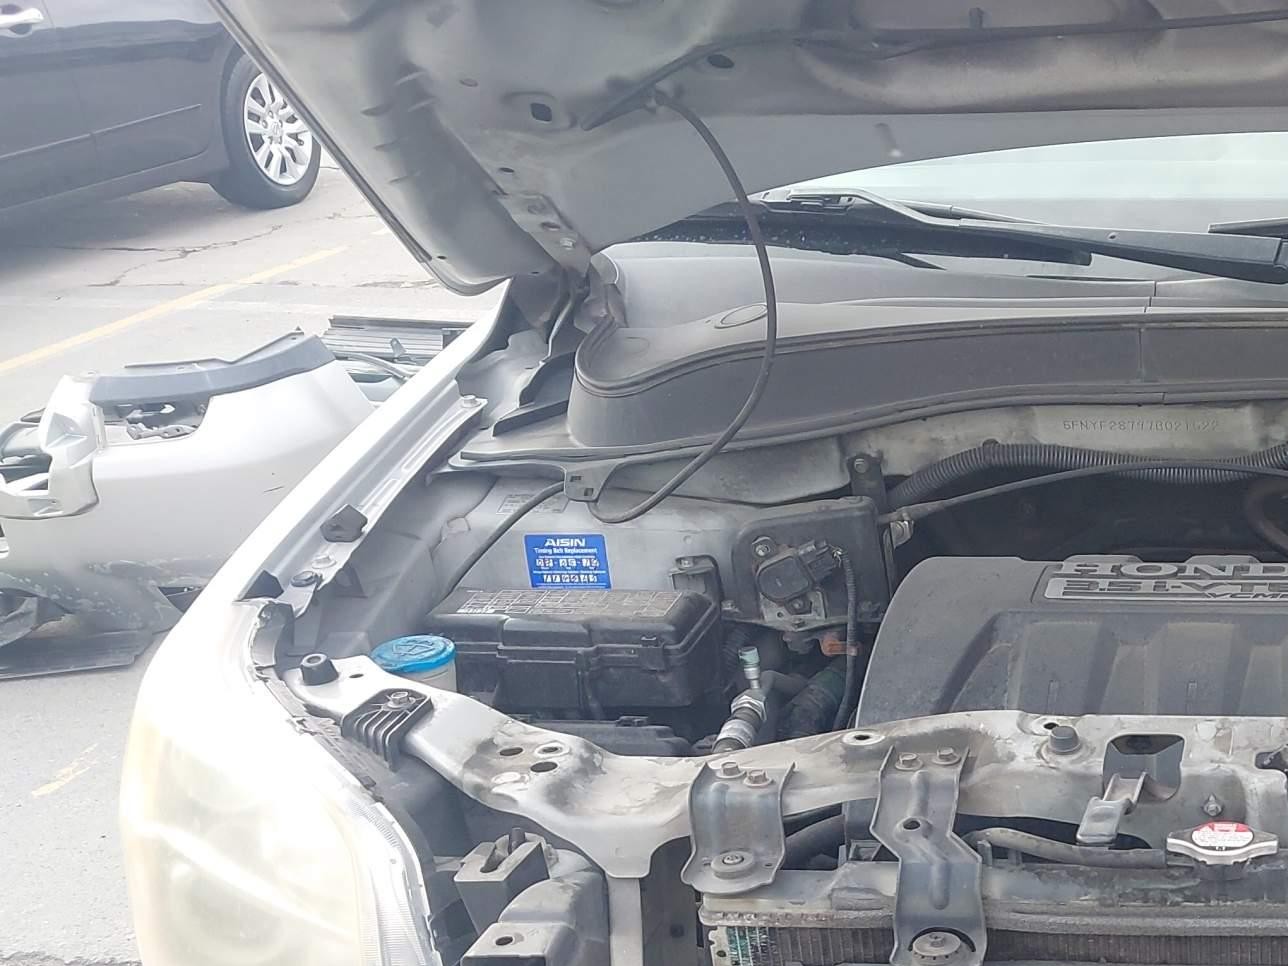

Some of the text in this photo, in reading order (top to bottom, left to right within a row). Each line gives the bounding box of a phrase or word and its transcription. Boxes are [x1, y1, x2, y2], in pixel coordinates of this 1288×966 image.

[544, 538, 586, 547] AISIN
[534, 547, 552, 555] Timing
[1062, 579, 1142, 592] 3.5
